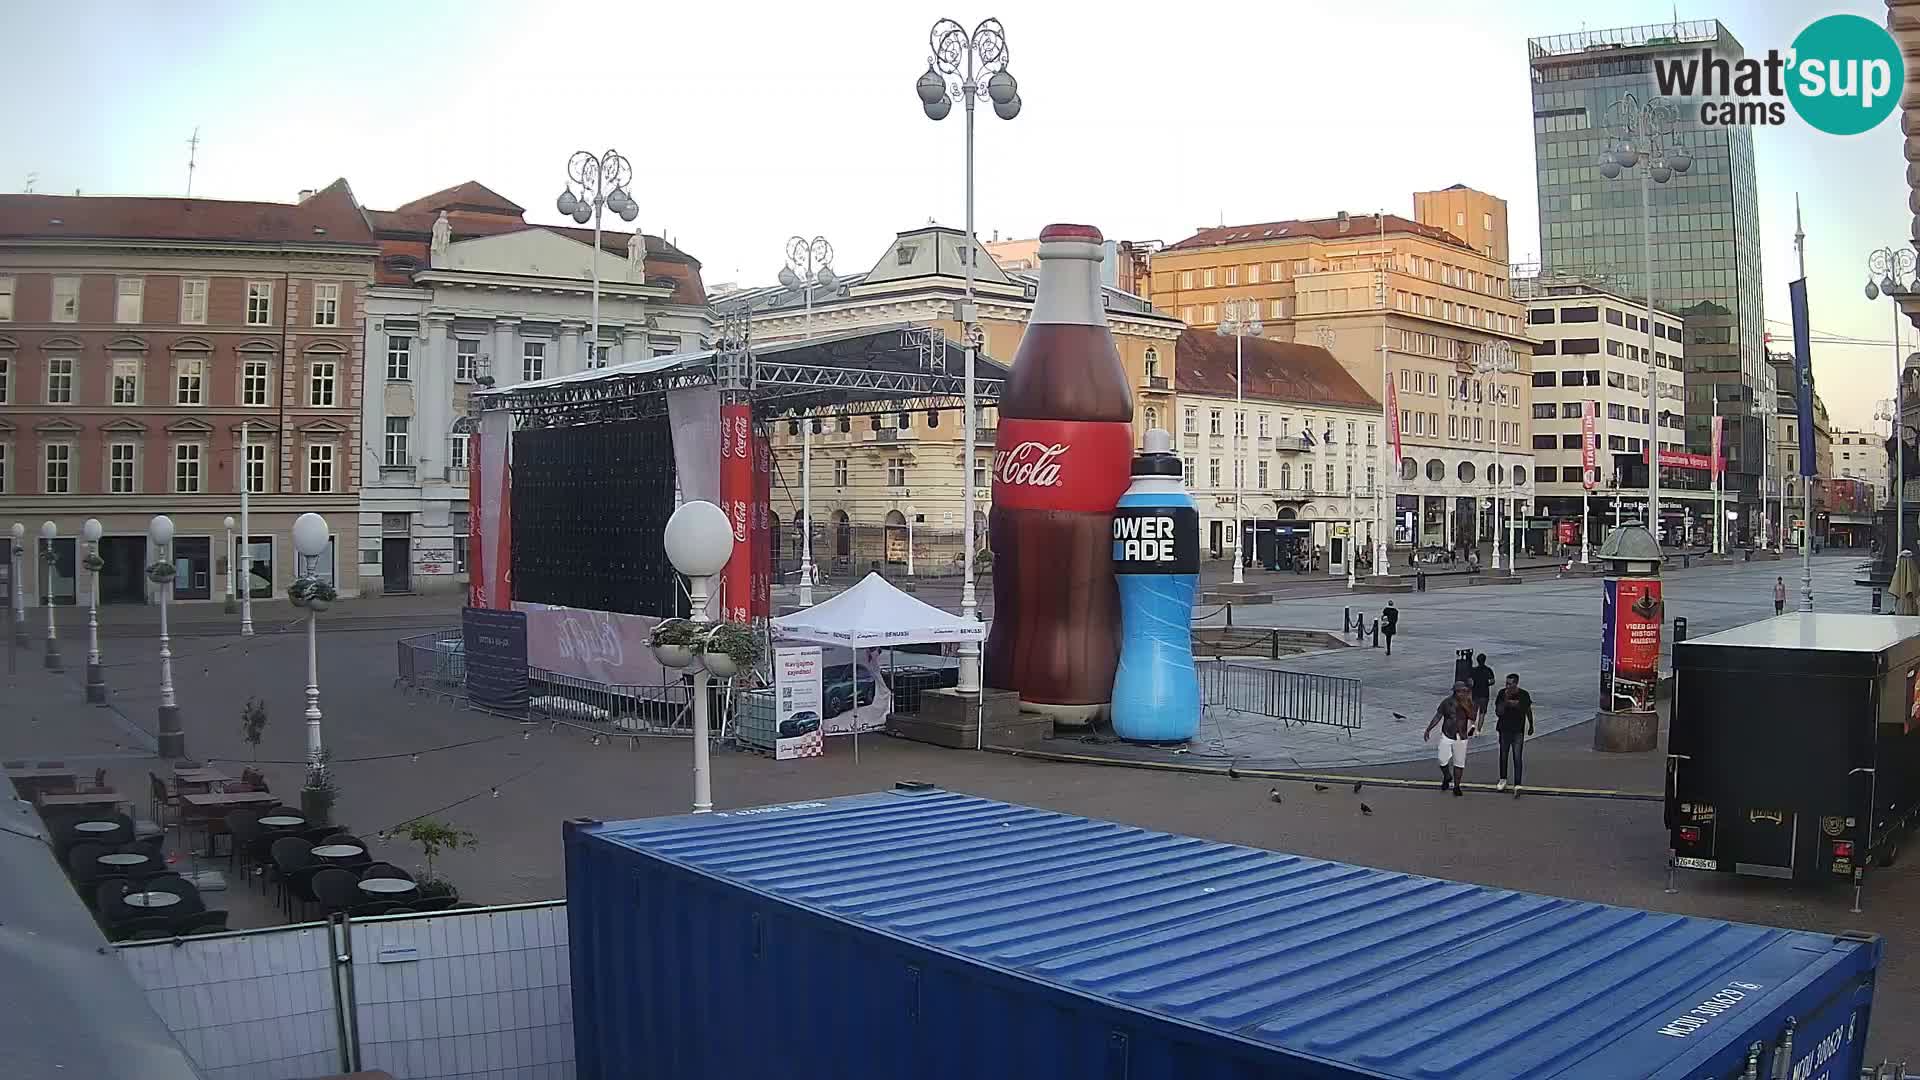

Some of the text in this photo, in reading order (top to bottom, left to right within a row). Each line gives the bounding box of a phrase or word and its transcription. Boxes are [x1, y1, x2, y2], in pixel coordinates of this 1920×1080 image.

[1113, 516, 1175, 539] OWER
[1657, 1014, 1708, 1037] MCDU
[1690, 988, 1746, 1017] 300629
